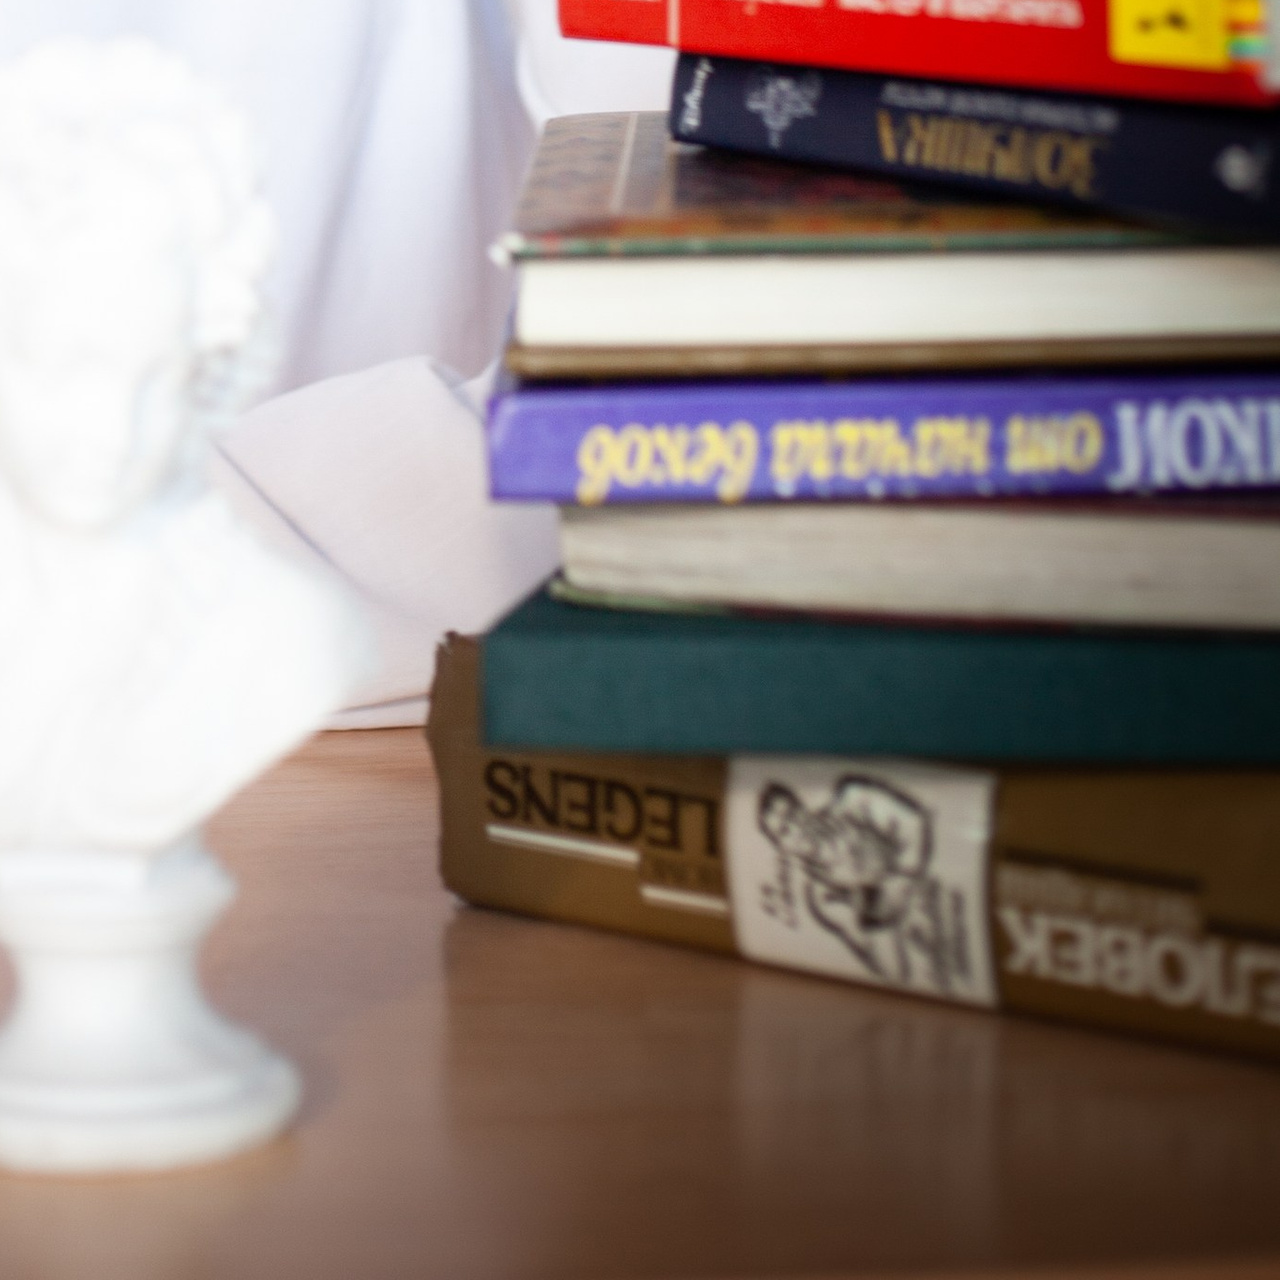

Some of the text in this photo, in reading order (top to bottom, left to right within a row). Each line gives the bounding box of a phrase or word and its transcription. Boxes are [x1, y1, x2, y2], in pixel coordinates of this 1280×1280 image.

[575, 419, 759, 506] веков
[770, 416, 991, 481] начала
[1004, 410, 1104, 474] от
[484, 759, 720, 857] LEGENS
